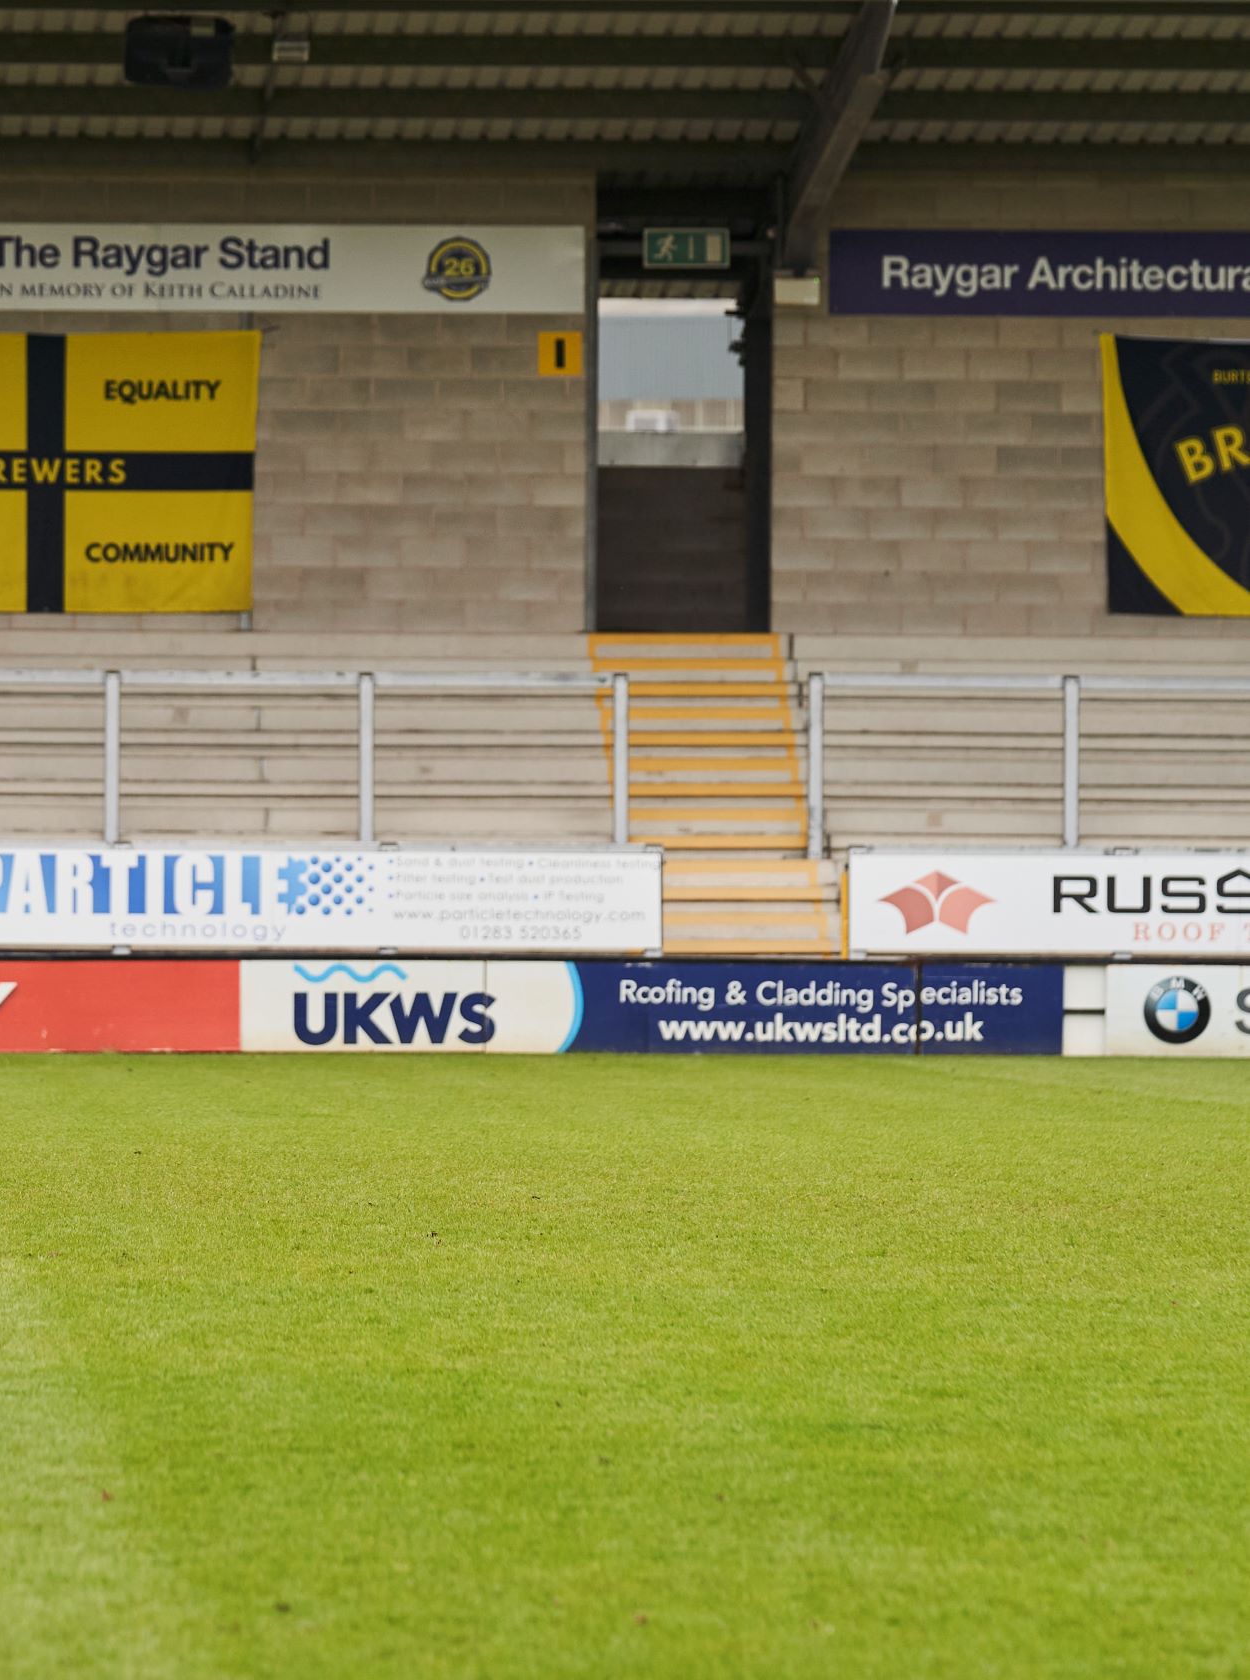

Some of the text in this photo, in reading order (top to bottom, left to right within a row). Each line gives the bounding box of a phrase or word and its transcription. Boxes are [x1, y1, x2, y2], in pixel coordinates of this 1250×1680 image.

[72, 235, 209, 277] Raygar
[218, 236, 330, 270] Stand
[881, 255, 1019, 297] Raygar
[104, 379, 221, 404] EQUALITY
[85, 541, 235, 564] COMMUNITY
[393, 908, 647, 924] www.particletechnology.com
[110, 920, 287, 942] technology
[459, 925, 582, 941] 01283 520365
[1133, 921, 1226, 942] ROOF
[725, 980, 747, 1006] &
[756, 979, 874, 1013] Cladding
[881, 979, 1023, 1015] Specialists
[1151, 976, 1207, 1001] BMW
[293, 991, 497, 1046] UKWS
[658, 1011, 984, 1044] www.ukwsltd.co.uk
